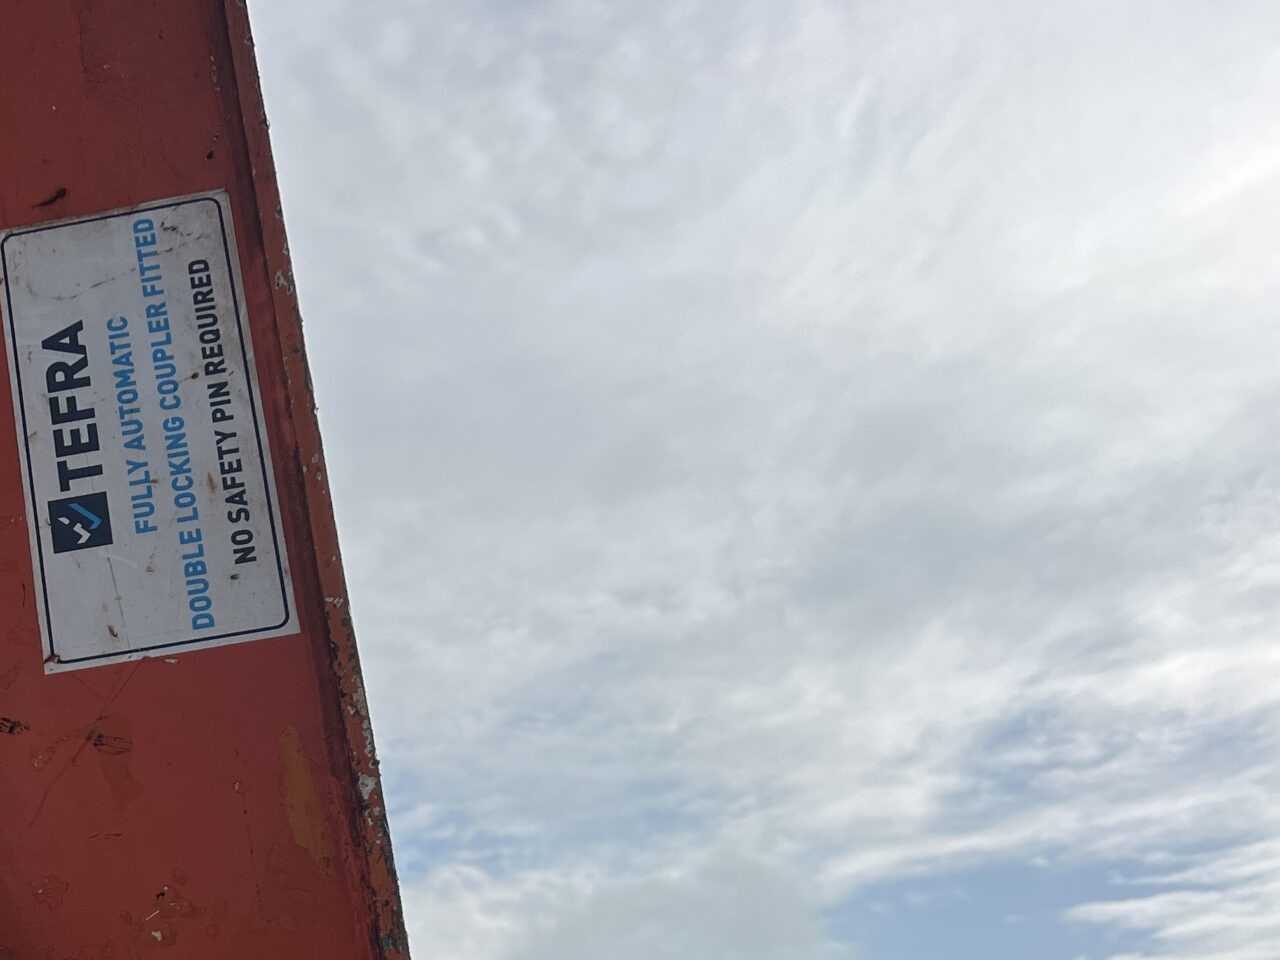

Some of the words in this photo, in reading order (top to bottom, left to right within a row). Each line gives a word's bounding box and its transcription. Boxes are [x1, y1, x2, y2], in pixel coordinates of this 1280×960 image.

[133, 218, 165, 297] FITTED
[145, 301, 182, 410] COUPLER
[188, 258, 225, 377] REQUIRED
[41, 319, 103, 492] TEFRA
[106, 315, 147, 450] AUTOMATIC
[207, 383, 237, 424] PIN
[126, 459, 157, 534] FULLY
[162, 415, 199, 523] LOCKING
[214, 430, 250, 524] SAFETY
[179, 528, 215, 630] DOUBLE
[230, 529, 257, 565] NO
